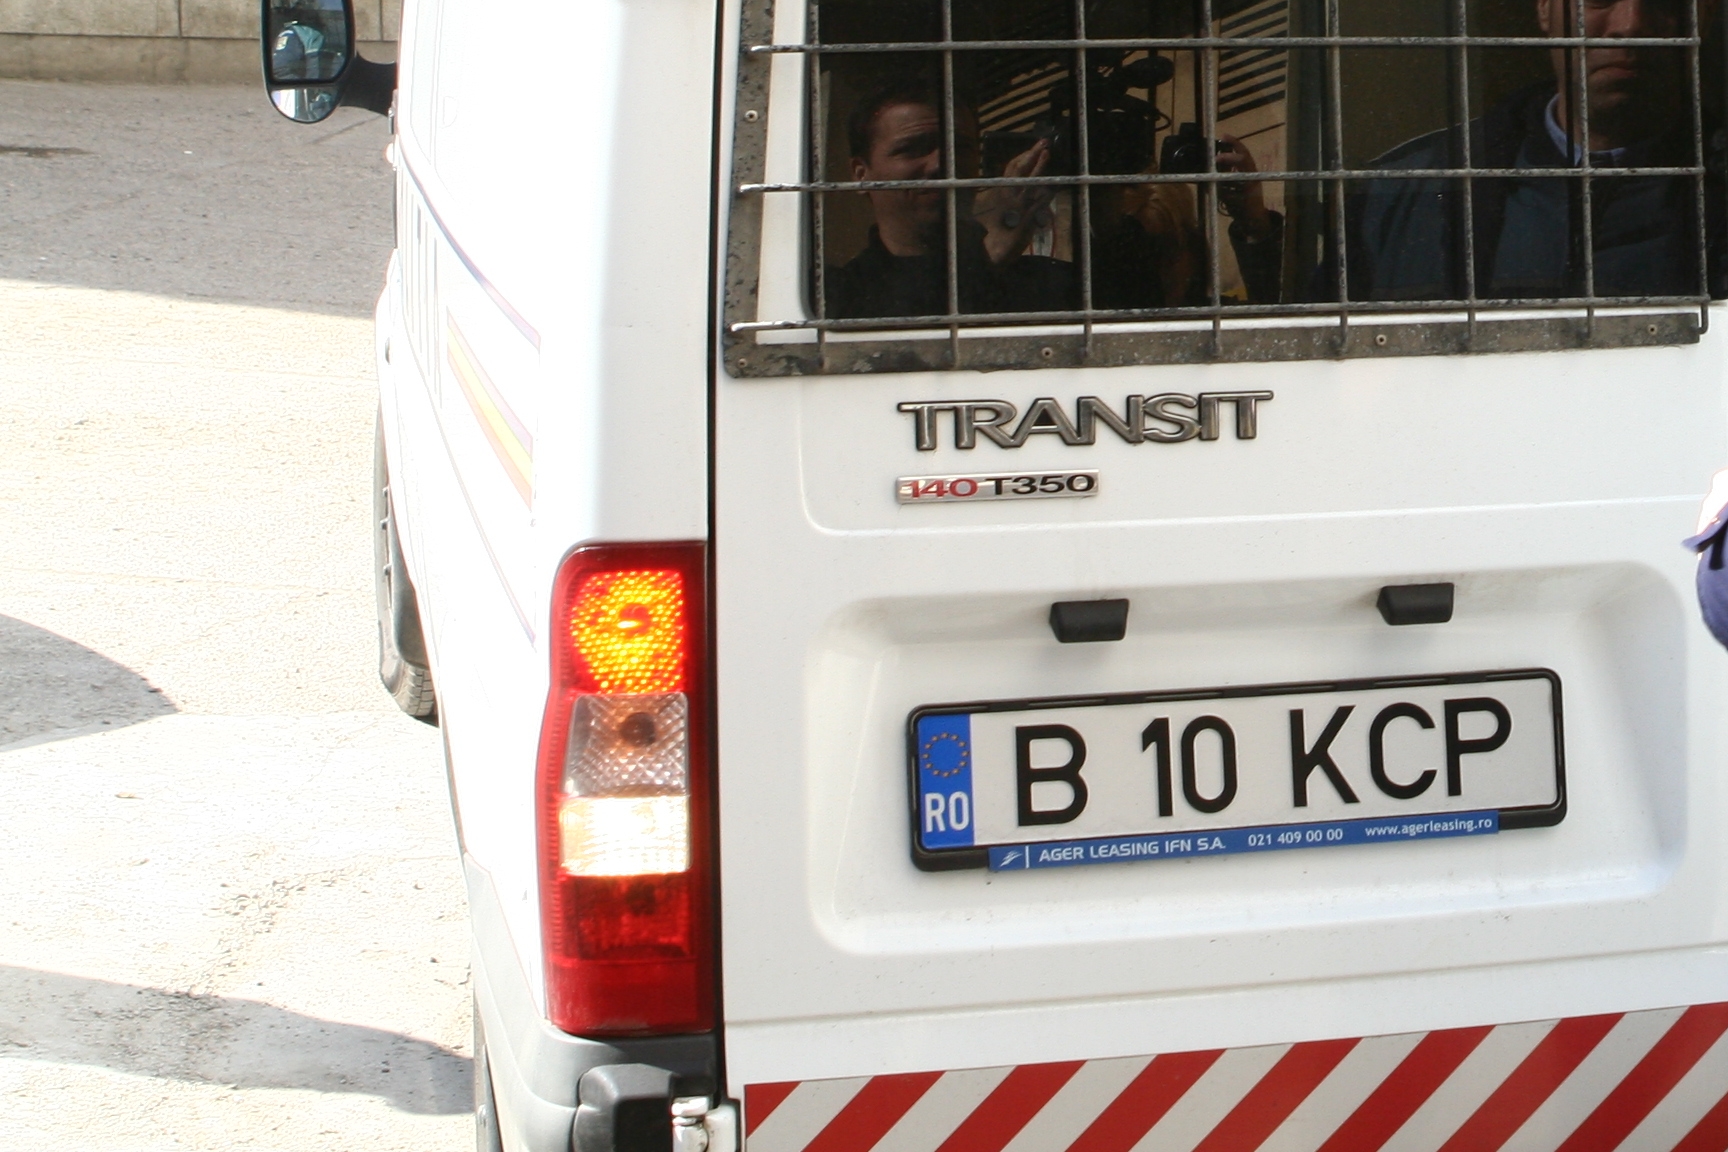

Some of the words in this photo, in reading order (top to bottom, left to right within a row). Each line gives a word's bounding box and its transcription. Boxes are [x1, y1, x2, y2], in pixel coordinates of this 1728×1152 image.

[897, 390, 1275, 451] TRANSIT
[909, 478, 979, 498] 140
[985, 473, 1096, 496] T350
[1015, 723, 1089, 828] B
[1141, 714, 1239, 817] 10
[1289, 696, 1513, 809] KCP
[925, 792, 970, 832] RO
[1039, 846, 1084, 863] AGER
[1089, 841, 1160, 859] LEASING
[1165, 838, 1192, 853] IFN
[1248, 833, 1272, 847] 021
[1277, 830, 1302, 845] 409
[1306, 829, 1323, 842] 00
[1326, 828, 1344, 841] 00
[1364, 818, 1493, 838] www.agerleasing.ro
